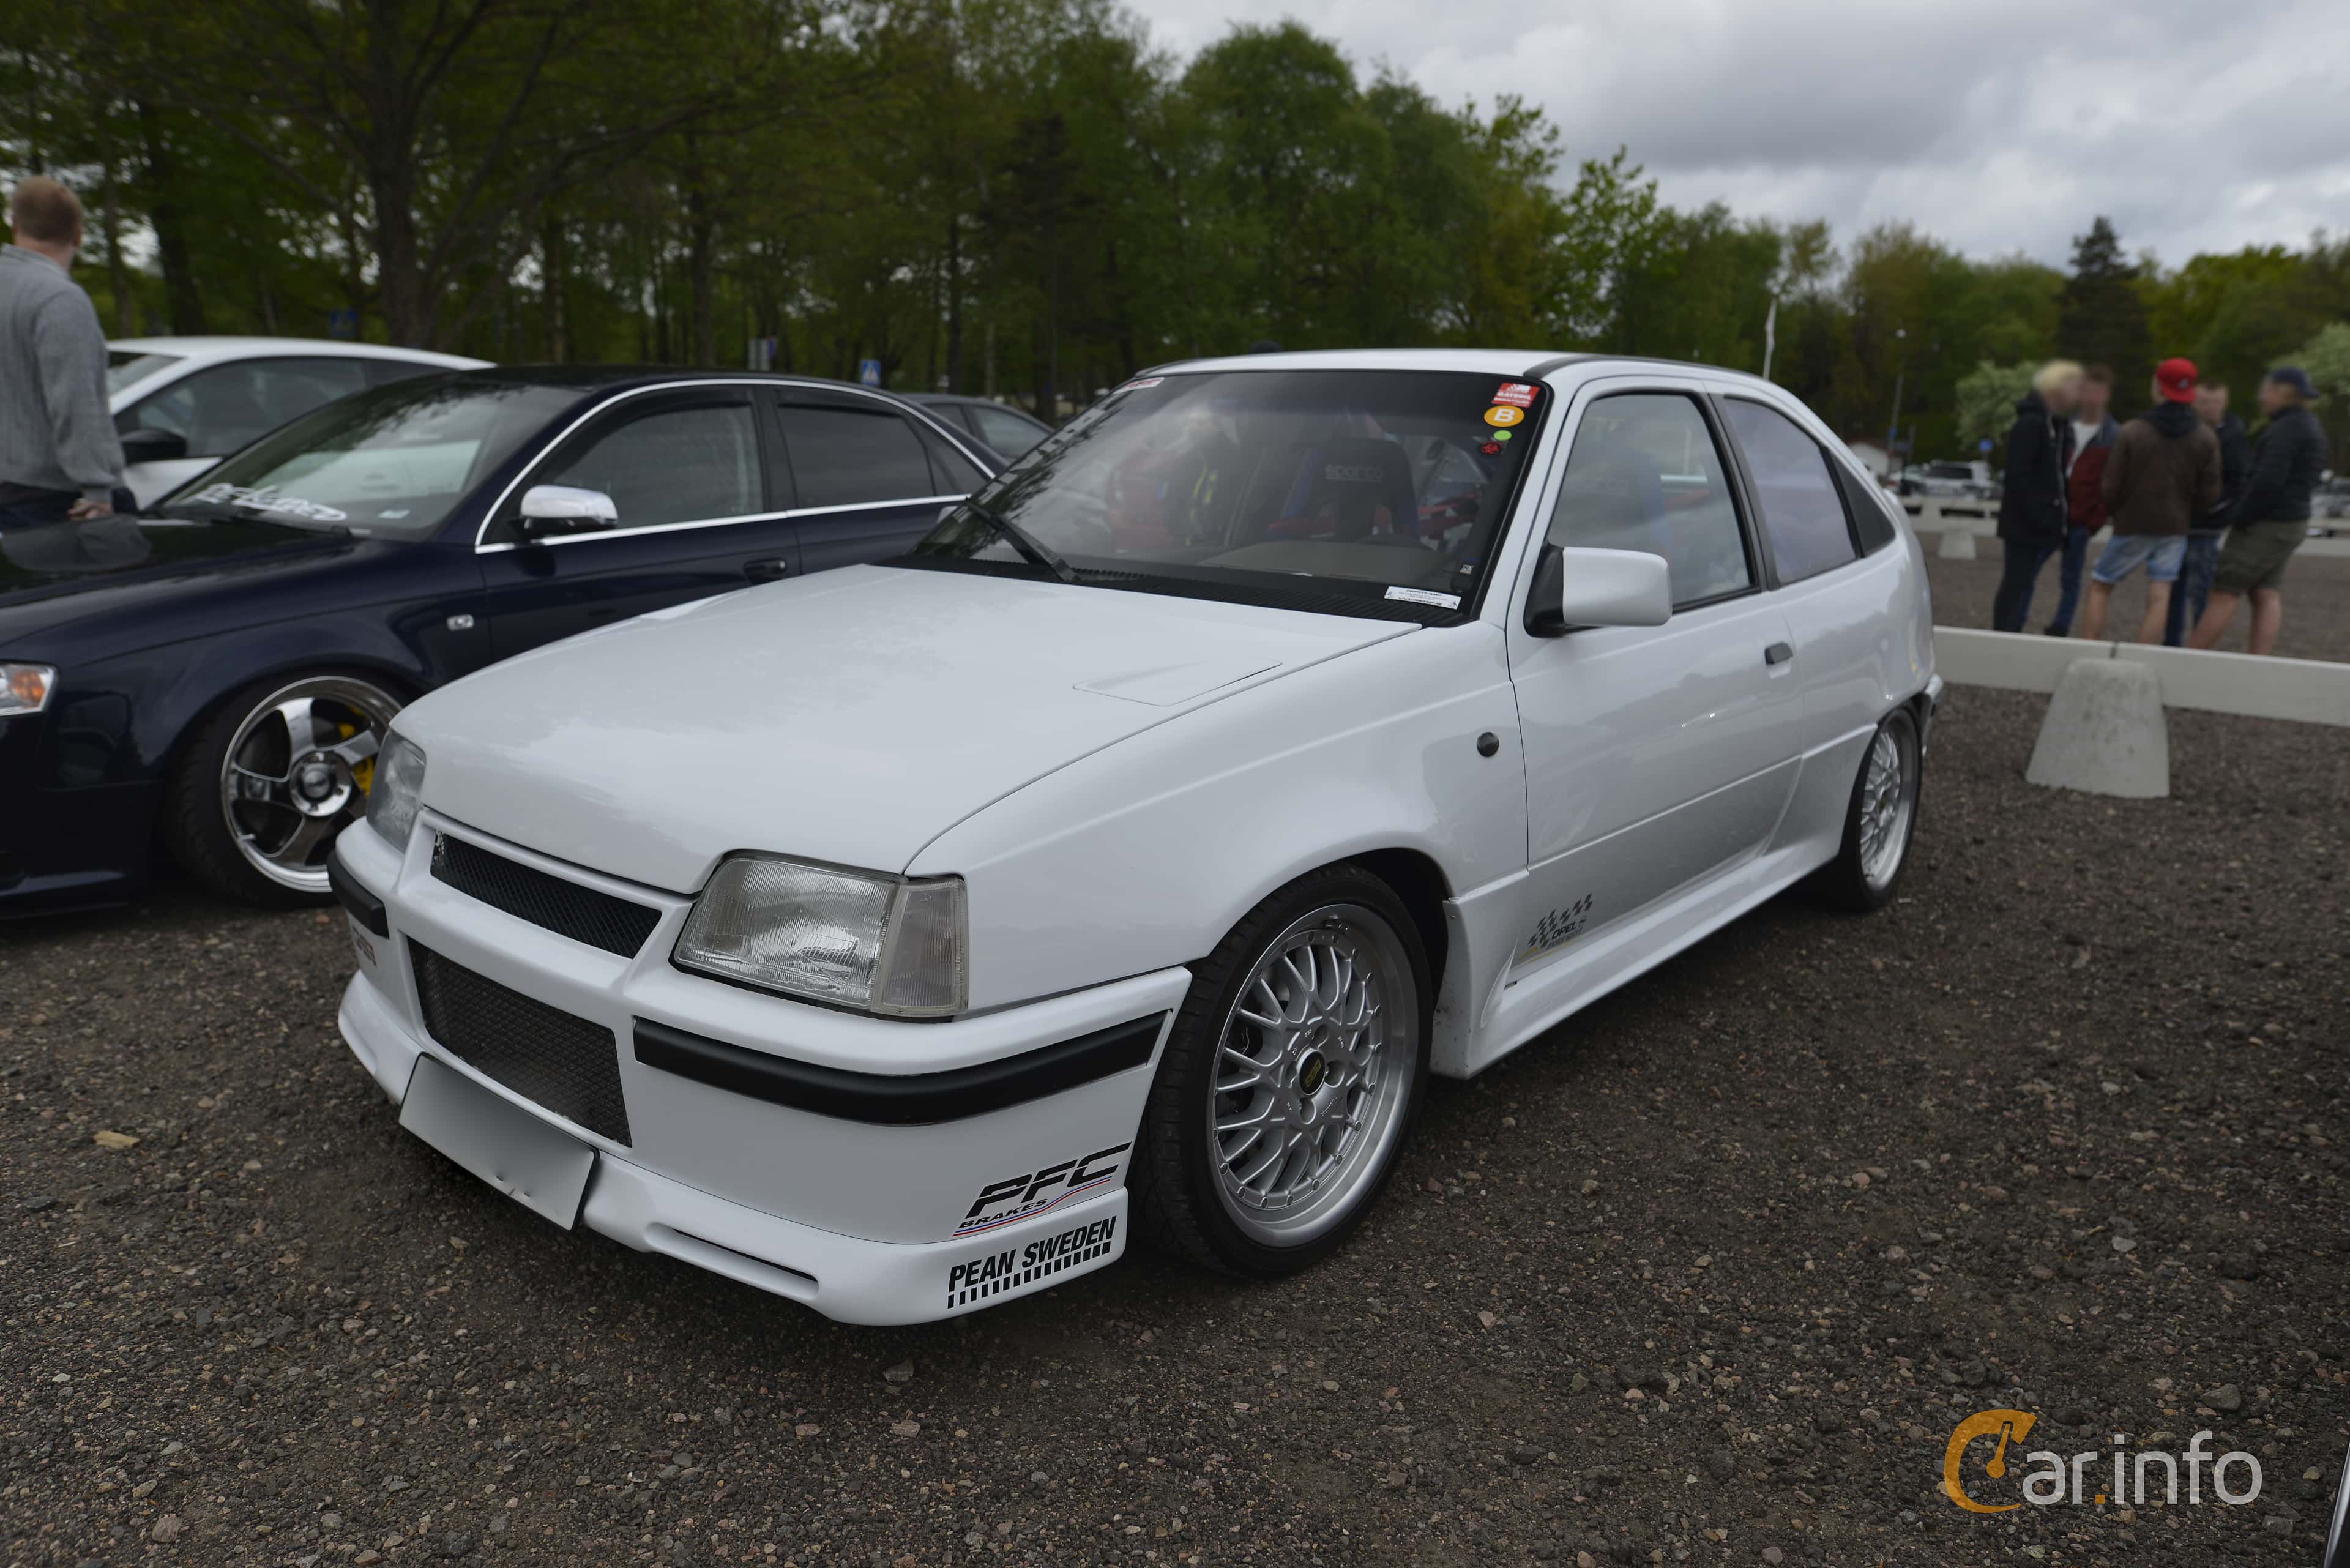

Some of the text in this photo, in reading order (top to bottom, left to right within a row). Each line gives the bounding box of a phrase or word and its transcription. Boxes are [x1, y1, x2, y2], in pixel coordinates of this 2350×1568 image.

[1493, 408, 1515, 422] B
[965, 1141, 1132, 1218] PFC
[958, 1198, 1048, 1228] BRAKES
[949, 1216, 1115, 1293] PEAN SWEDEN
